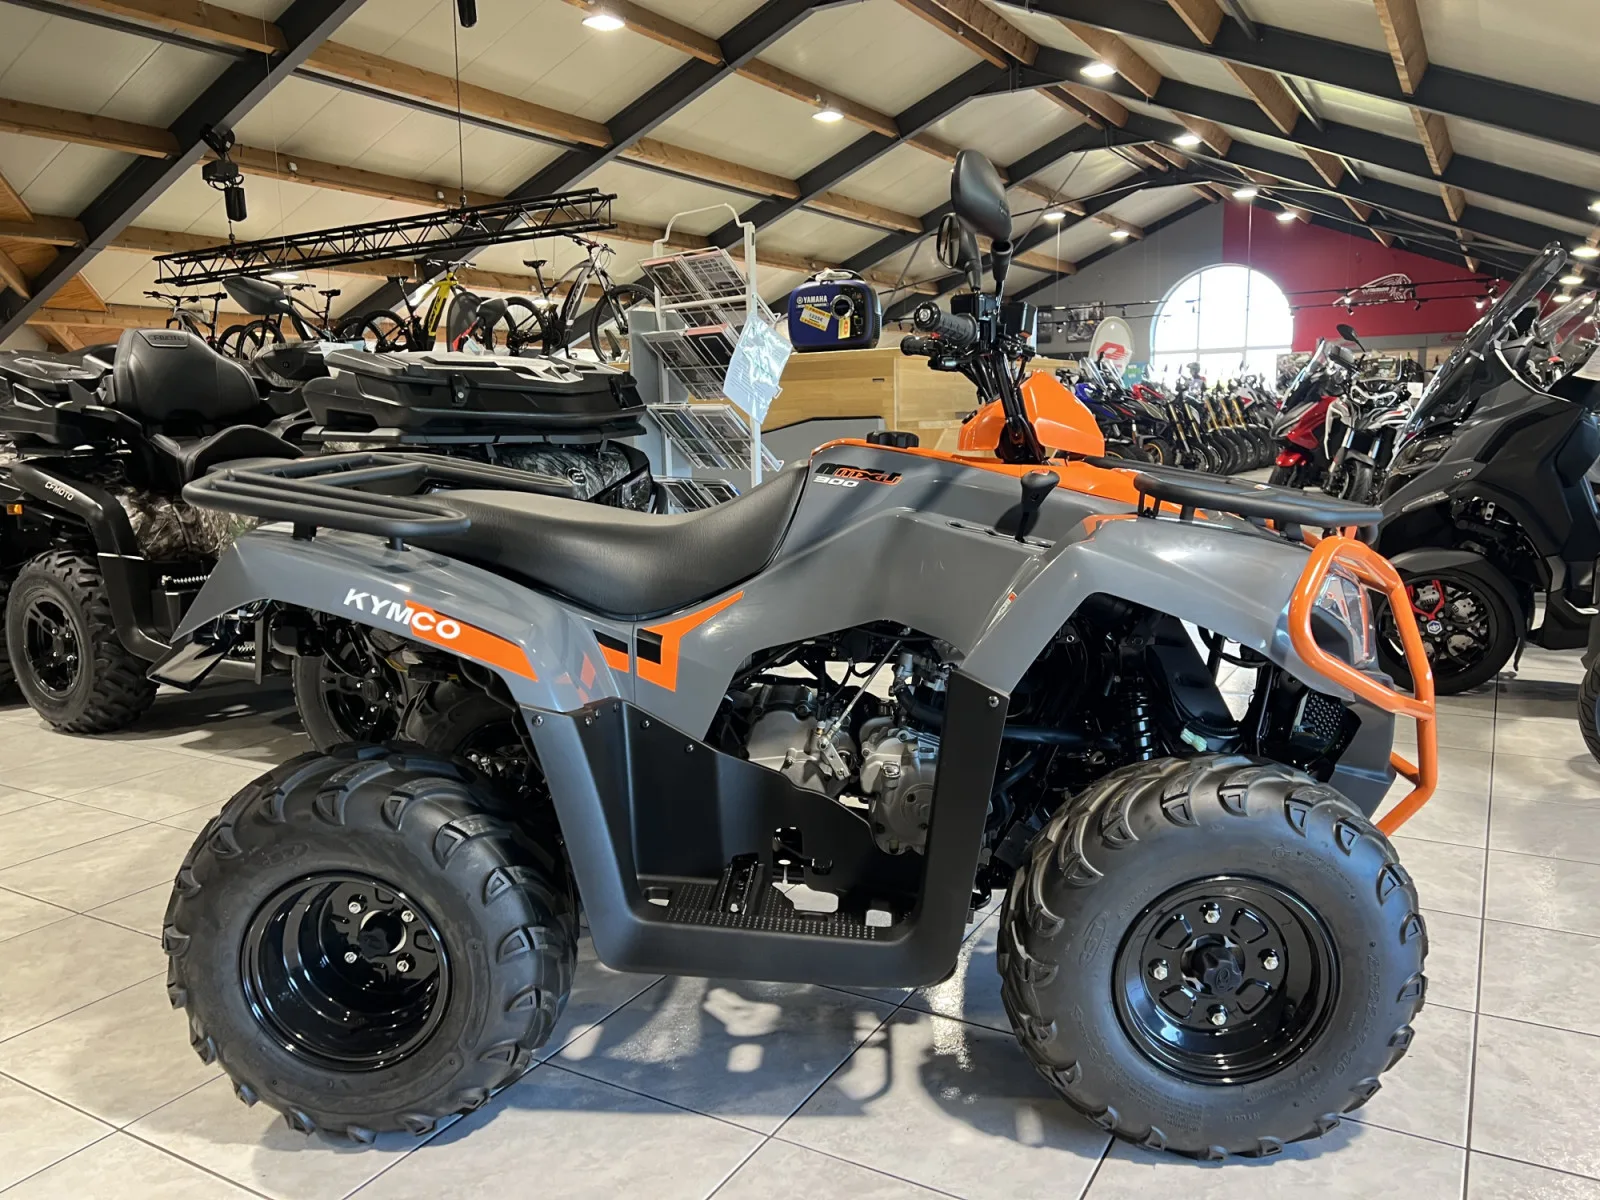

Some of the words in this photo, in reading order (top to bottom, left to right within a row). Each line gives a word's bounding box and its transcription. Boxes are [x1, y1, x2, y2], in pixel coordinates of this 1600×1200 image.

[803, 295, 828, 304] YAMAHA
[813, 475, 860, 488] 300
[44, 480, 75, 501] CFMOTO
[343, 588, 460, 639] KYMCO
